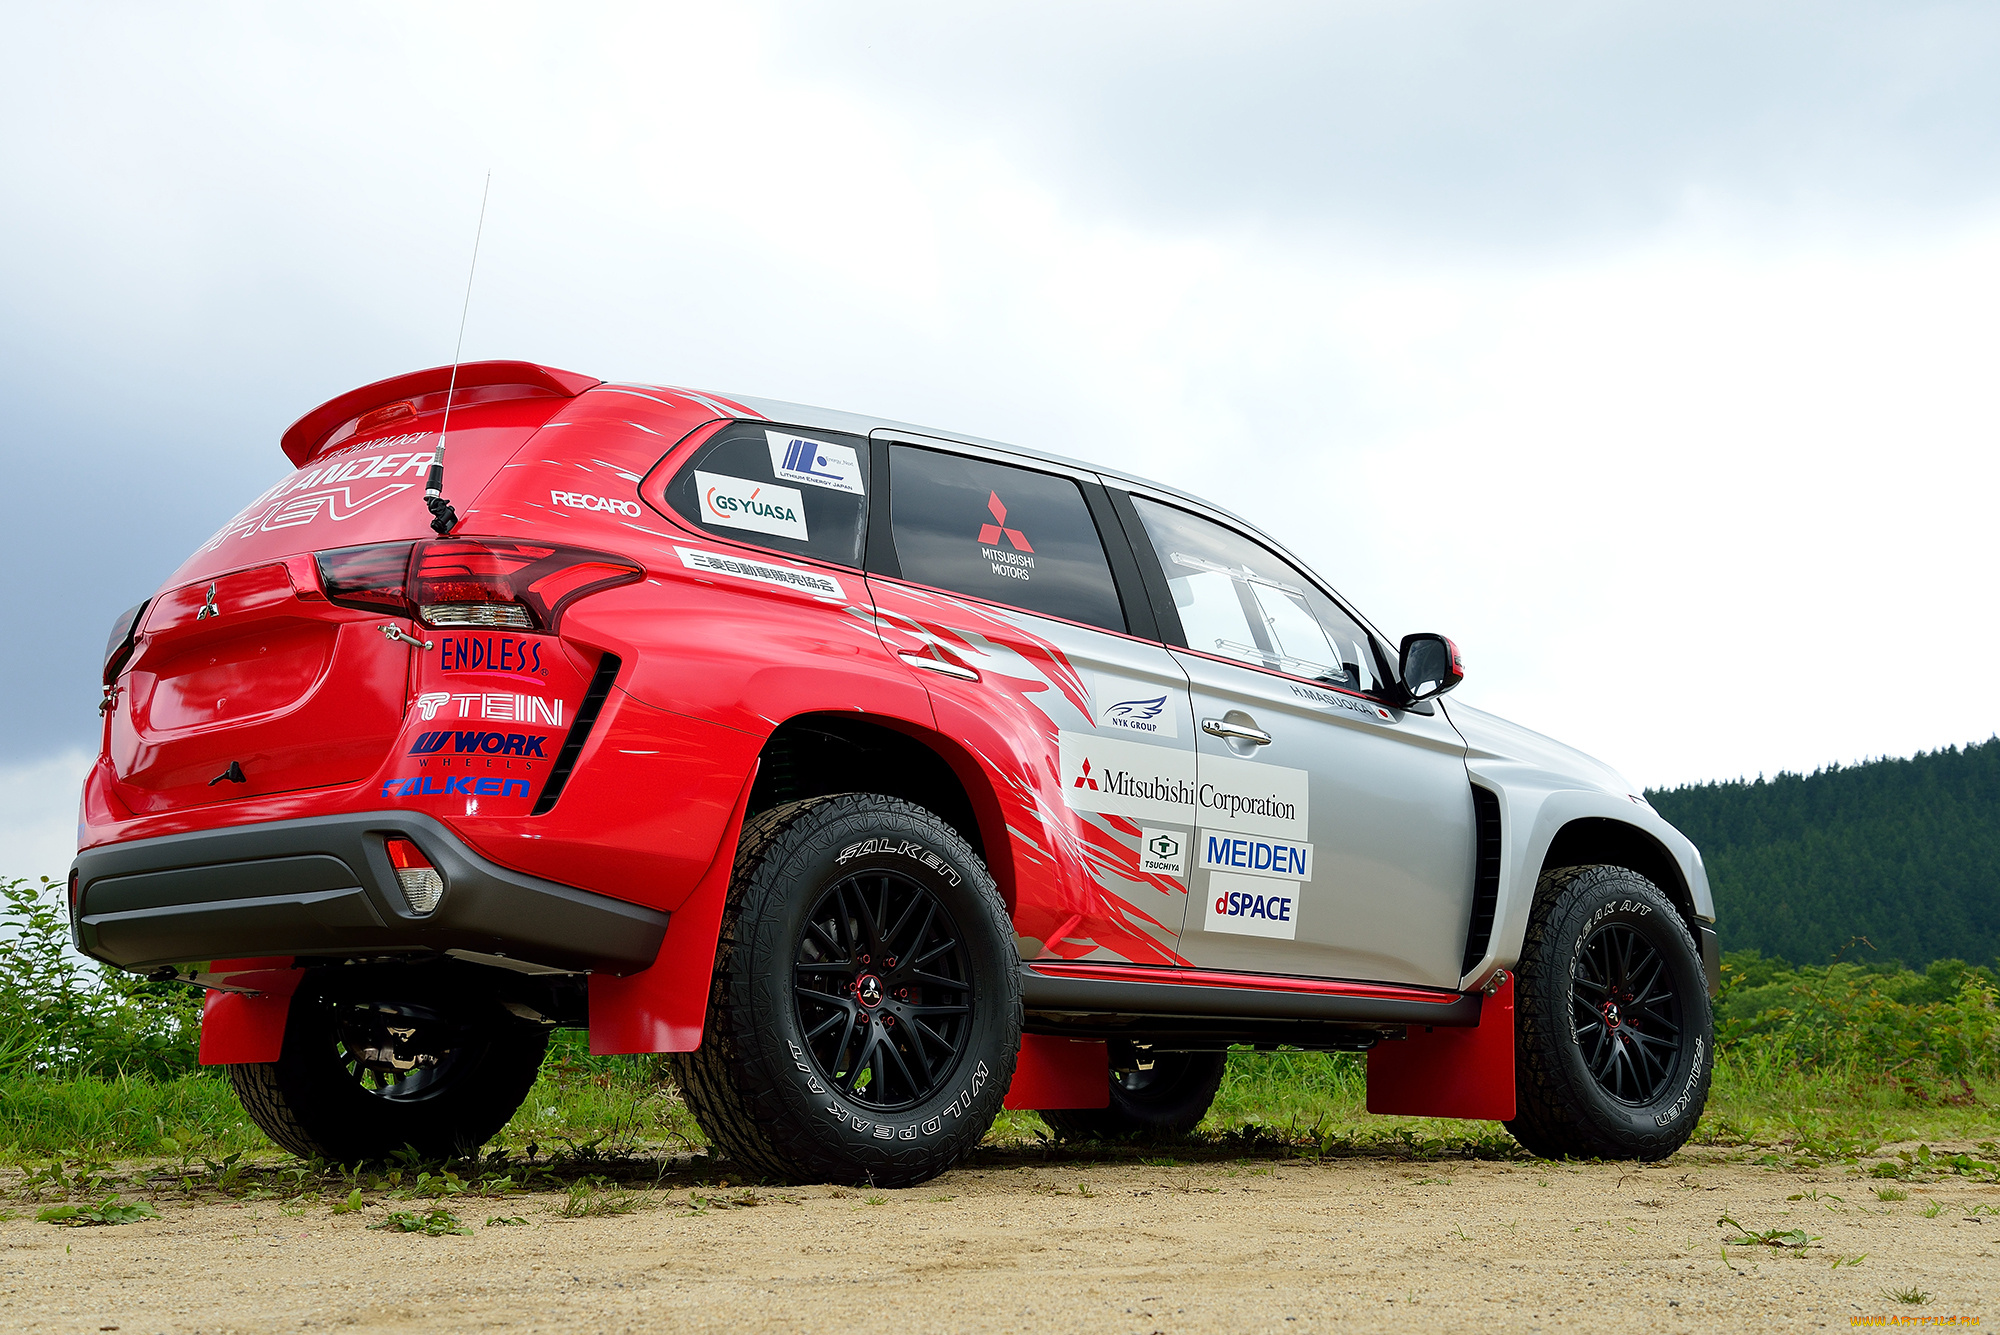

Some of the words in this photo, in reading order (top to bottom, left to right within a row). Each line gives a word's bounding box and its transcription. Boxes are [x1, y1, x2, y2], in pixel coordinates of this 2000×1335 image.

[780, 471, 805, 481] LITHIUM
[806, 476, 831, 486] ENERGY
[832, 482, 853, 491] JAPAN
[551, 489, 641, 518] RECARO
[690, 553, 835, 593] 三菱自動車販売協会
[981, 547, 1035, 569] MITSUBISHI
[991, 562, 1030, 581] MOTORS
[441, 637, 542, 673] ENDLESS
[1289, 684, 1373, 716] H.MASUOKA
[1112, 717, 1129, 729] NYK
[1130, 720, 1157, 733] GROUP
[454, 731, 548, 758] WORK
[381, 776, 531, 799] FALKEN
[1103, 768, 1195, 805] Mitsubishi
[1199, 784, 1296, 820] Corporation
[834, 837, 962, 888] FALKEN
[1144, 860, 1180, 872] TSUCHIYA
[1206, 836, 1307, 875] MEIDEN
[1215, 891, 1292, 922] dSPACE
[1655, 1034, 1705, 1128] FALKEN
[825, 1060, 990, 1141] WILDPEAK
